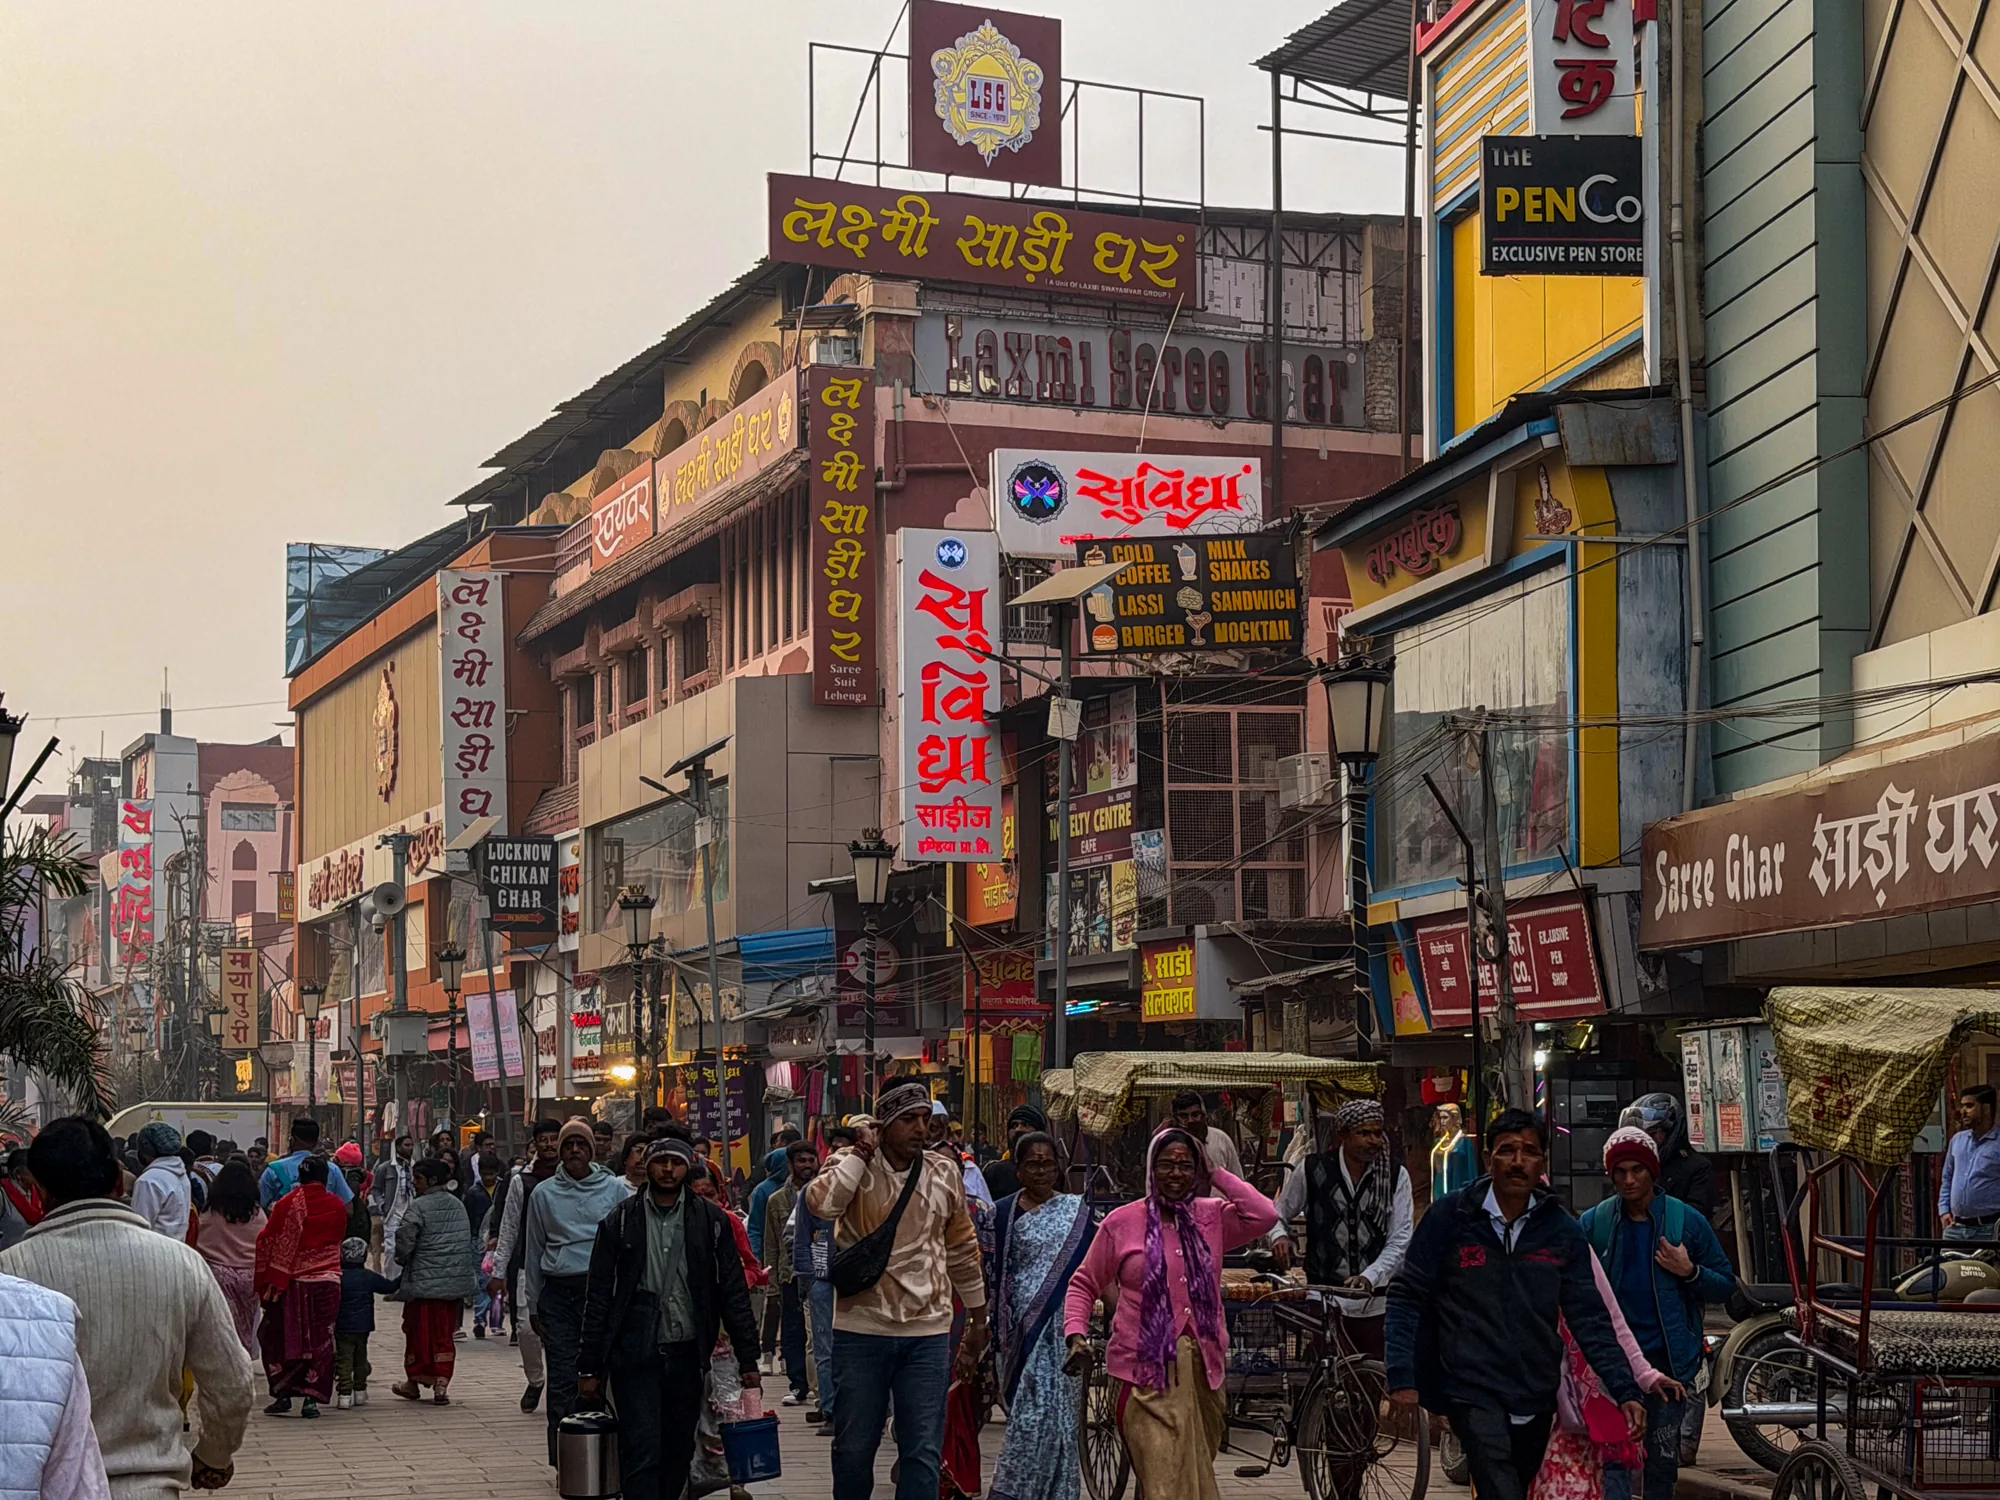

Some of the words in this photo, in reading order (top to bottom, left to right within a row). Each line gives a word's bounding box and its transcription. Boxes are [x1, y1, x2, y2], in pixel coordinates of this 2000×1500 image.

[970, 80, 1005, 112] LSG
[1491, 148, 1532, 167] THE
[782, 195, 939, 259] लक्ष्मी
[955, 211, 1074, 283] साड़ी
[1092, 232, 1179, 288] घर
[1492, 246, 1565, 263] EXCLUSIVE
[1569, 246, 1596, 263] PEN
[1600, 246, 1643, 263] STORE
[1109, 329, 1230, 414] Saree
[748, 406, 772, 457] घर
[1075, 461, 1246, 530] सुविधा
[593, 475, 651, 557] स्वयंवर
[1112, 543, 1154, 564] COLD
[1206, 539, 1247, 560] MILK
[1114, 564, 1172, 586] COFFEE
[1209, 560, 1271, 582] SHAKES
[1118, 593, 1164, 616] LASSI
[1211, 588, 1296, 613] SANDWICH
[1121, 623, 1185, 648] BURGER
[1214, 619, 1292, 644] MOCKTAIL
[829, 663, 862, 675] Saree
[833, 676, 857, 688] Suit
[824, 690, 867, 704] Lehenga
[914, 795, 993, 834] साड़ीज
[1093, 802, 1132, 833] CENTRE
[488, 843, 552, 861] LUCKNOW
[1080, 838, 1097, 854] CAFE
[1808, 781, 1919, 909] साड़ी
[490, 865, 549, 885] CHIKAN
[1654, 850, 1715, 921] Saree
[1726, 833, 1785, 903] Ghar
[497, 889, 542, 909] GHAR
[1154, 943, 1193, 984] साड़ी
[1550, 950, 1563, 965] PEN
[1478, 964, 1493, 987] HE
[1551, 971, 1568, 987] SHOP
[1143, 982, 1194, 1017] सलेक्शन
